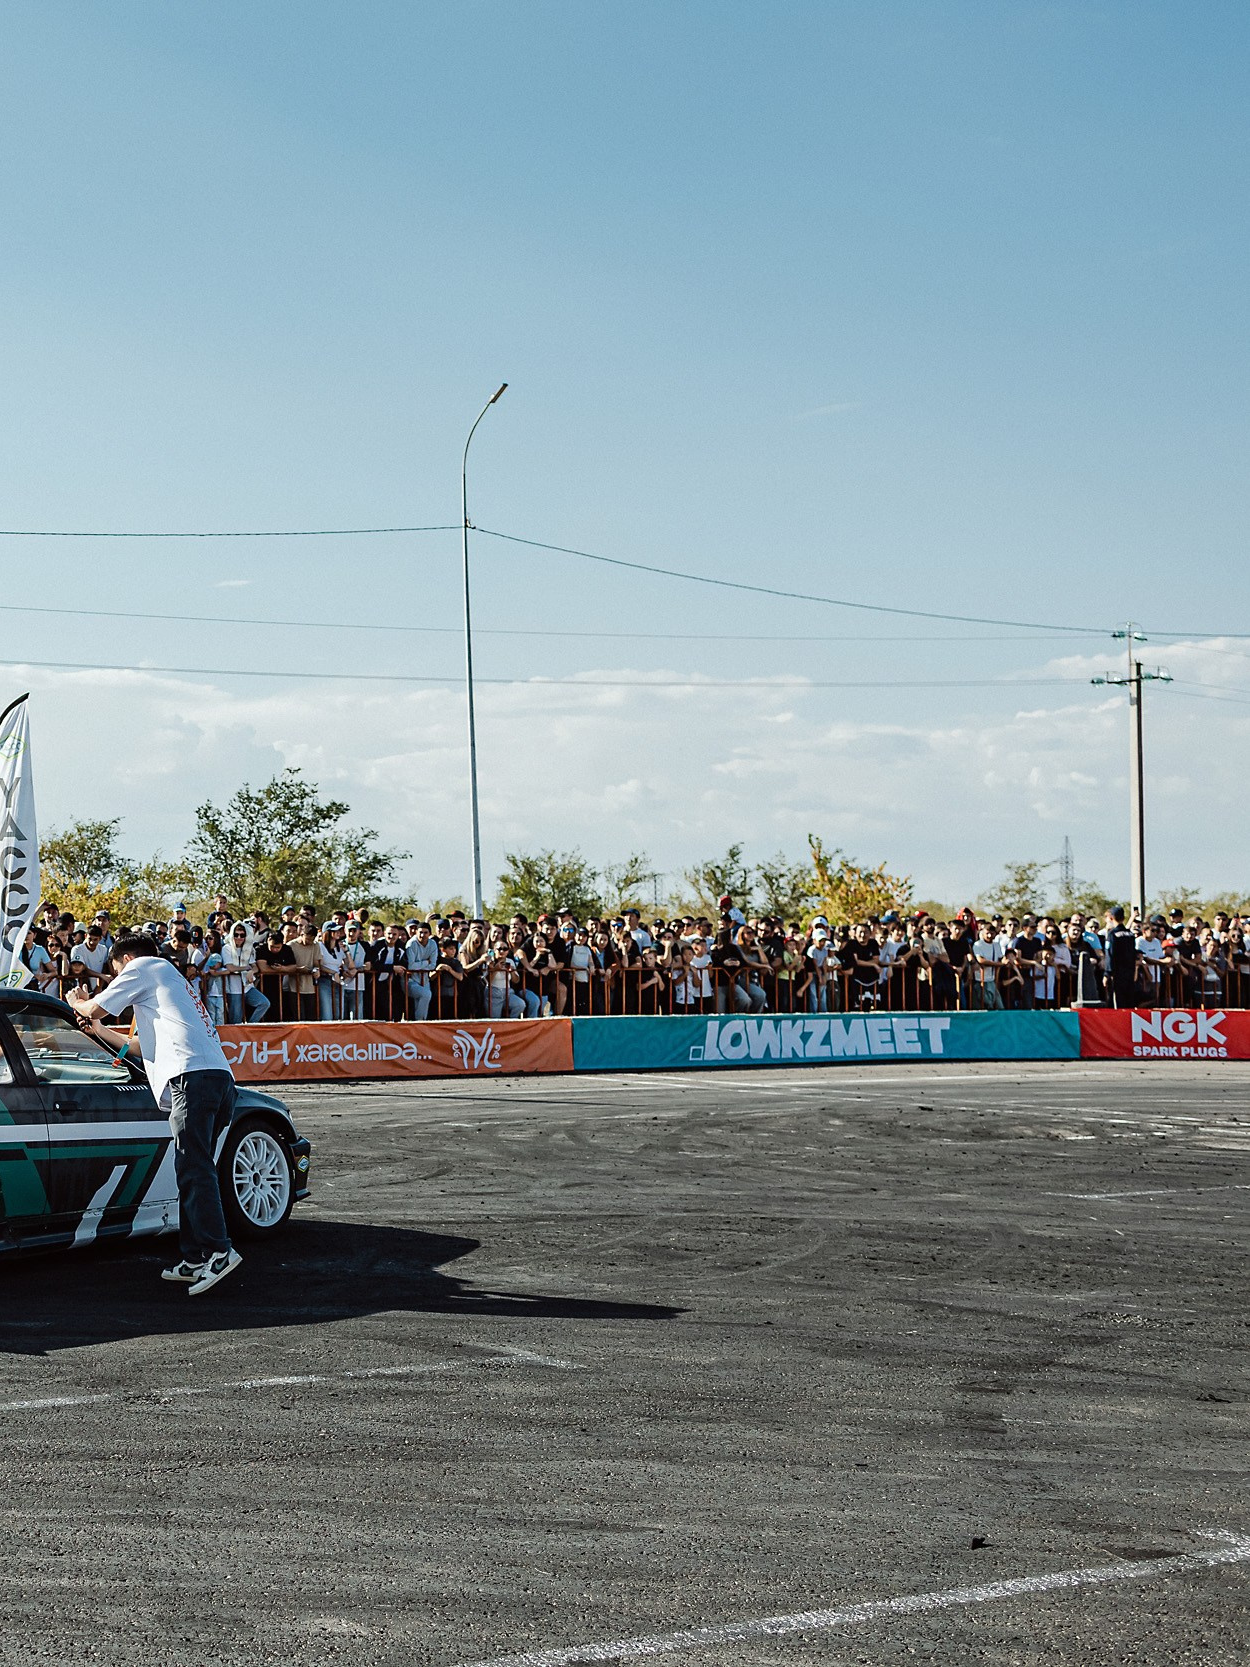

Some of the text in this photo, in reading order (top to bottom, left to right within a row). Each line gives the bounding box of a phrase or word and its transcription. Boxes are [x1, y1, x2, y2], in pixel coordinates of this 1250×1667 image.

[1131, 1011, 1227, 1045] NGK
[1133, 1045, 1228, 1058] SPARK PLUGS
